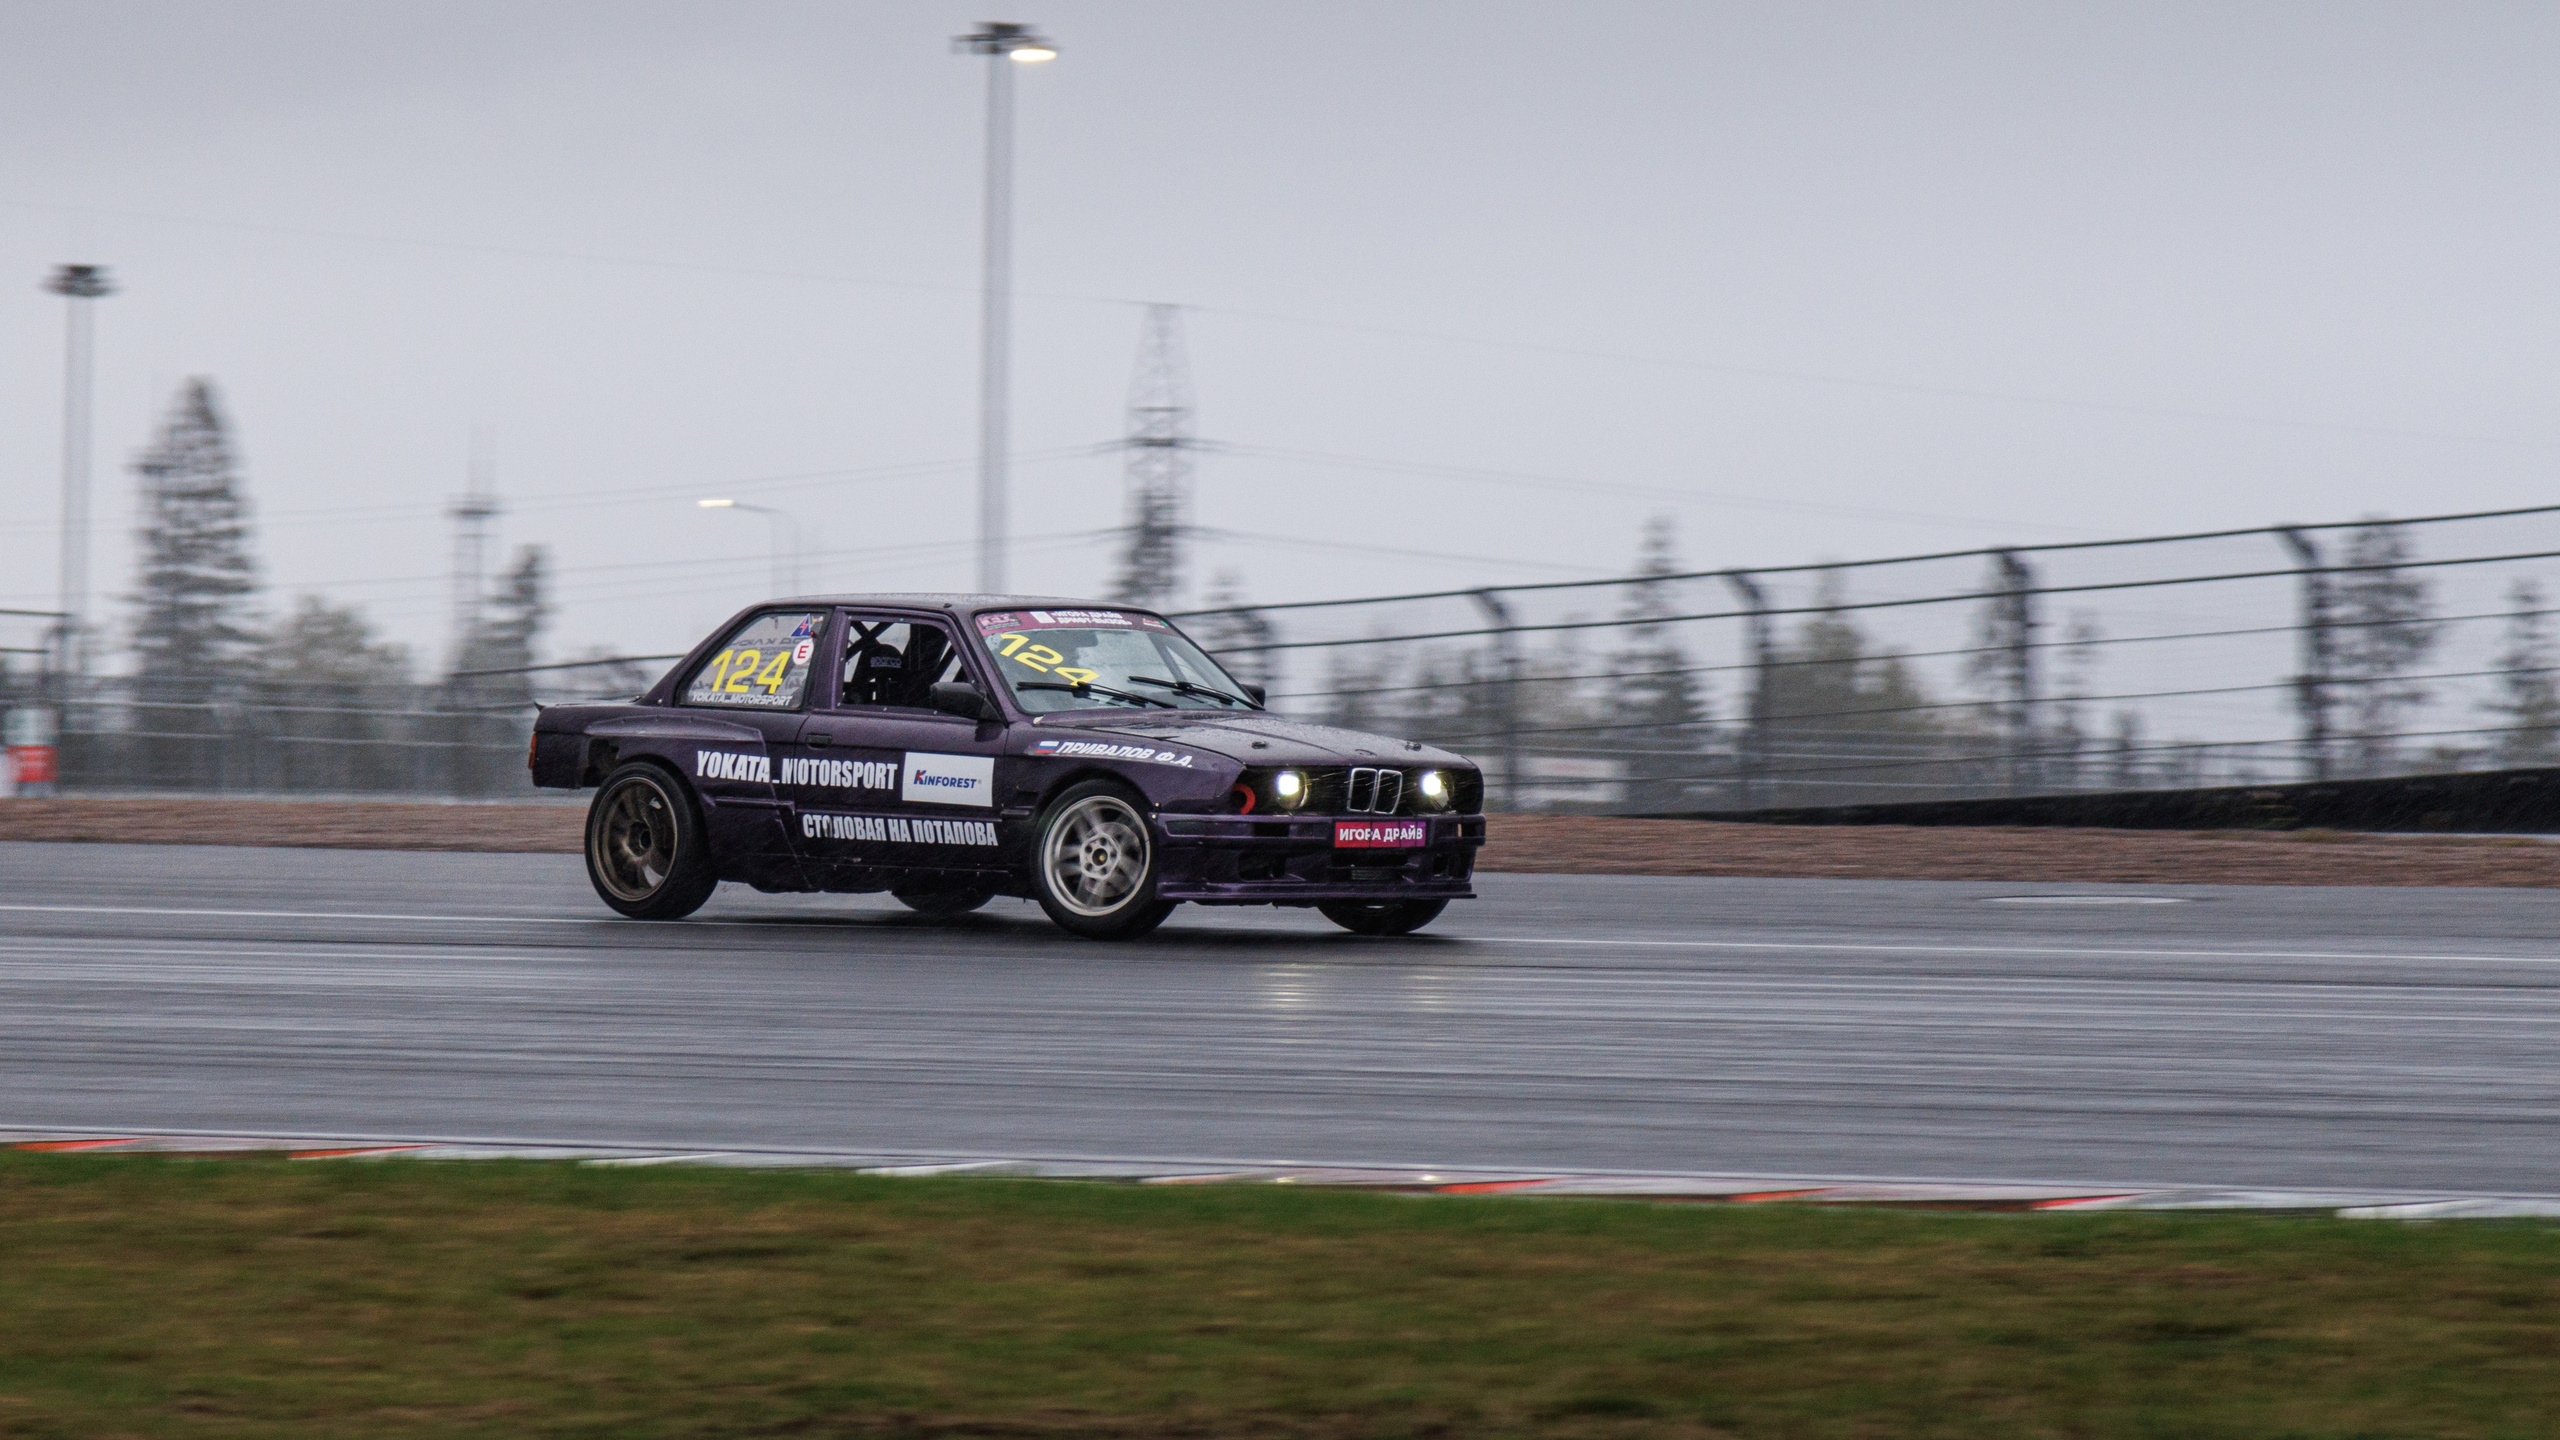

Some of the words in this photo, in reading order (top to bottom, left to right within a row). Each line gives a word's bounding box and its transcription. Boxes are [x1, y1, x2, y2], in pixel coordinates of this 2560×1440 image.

[797, 645, 809, 659] E
[1000, 633, 1100, 687] 124
[711, 649, 791, 694] 124
[1056, 742, 1155, 759] ПРИВАЛОВ
[1155, 752, 1193, 768] Ф.А.
[913, 769, 977, 788] KINFOREST
[888, 818, 912, 842] НА
[912, 820, 999, 846] ПОТАПОВА
[1339, 828, 1381, 840] ИГОРА
[1383, 825, 1423, 842] ДРАЙВ
